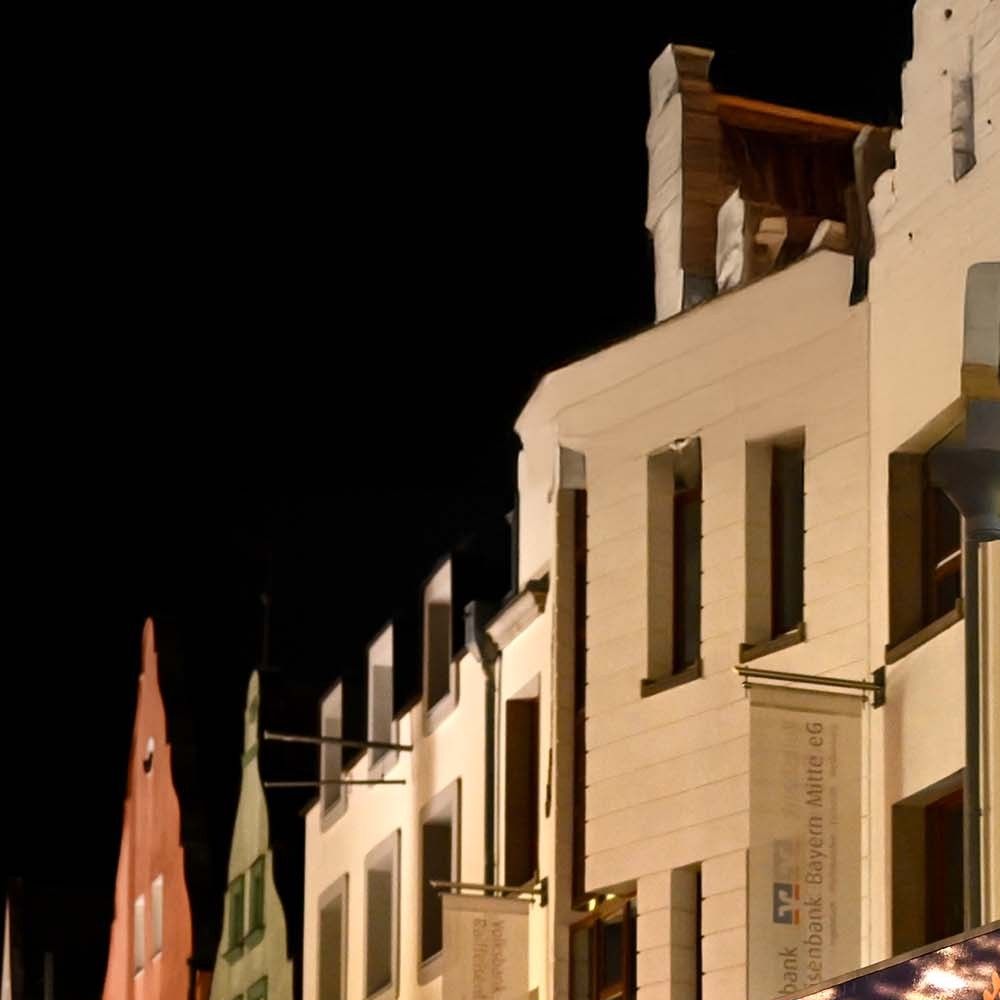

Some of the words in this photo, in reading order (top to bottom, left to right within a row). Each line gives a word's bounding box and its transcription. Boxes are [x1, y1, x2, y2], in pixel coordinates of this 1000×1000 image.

[806, 721, 824, 748] eG
[805, 759, 824, 808] Mitte
[806, 815, 828, 885] Bayern
